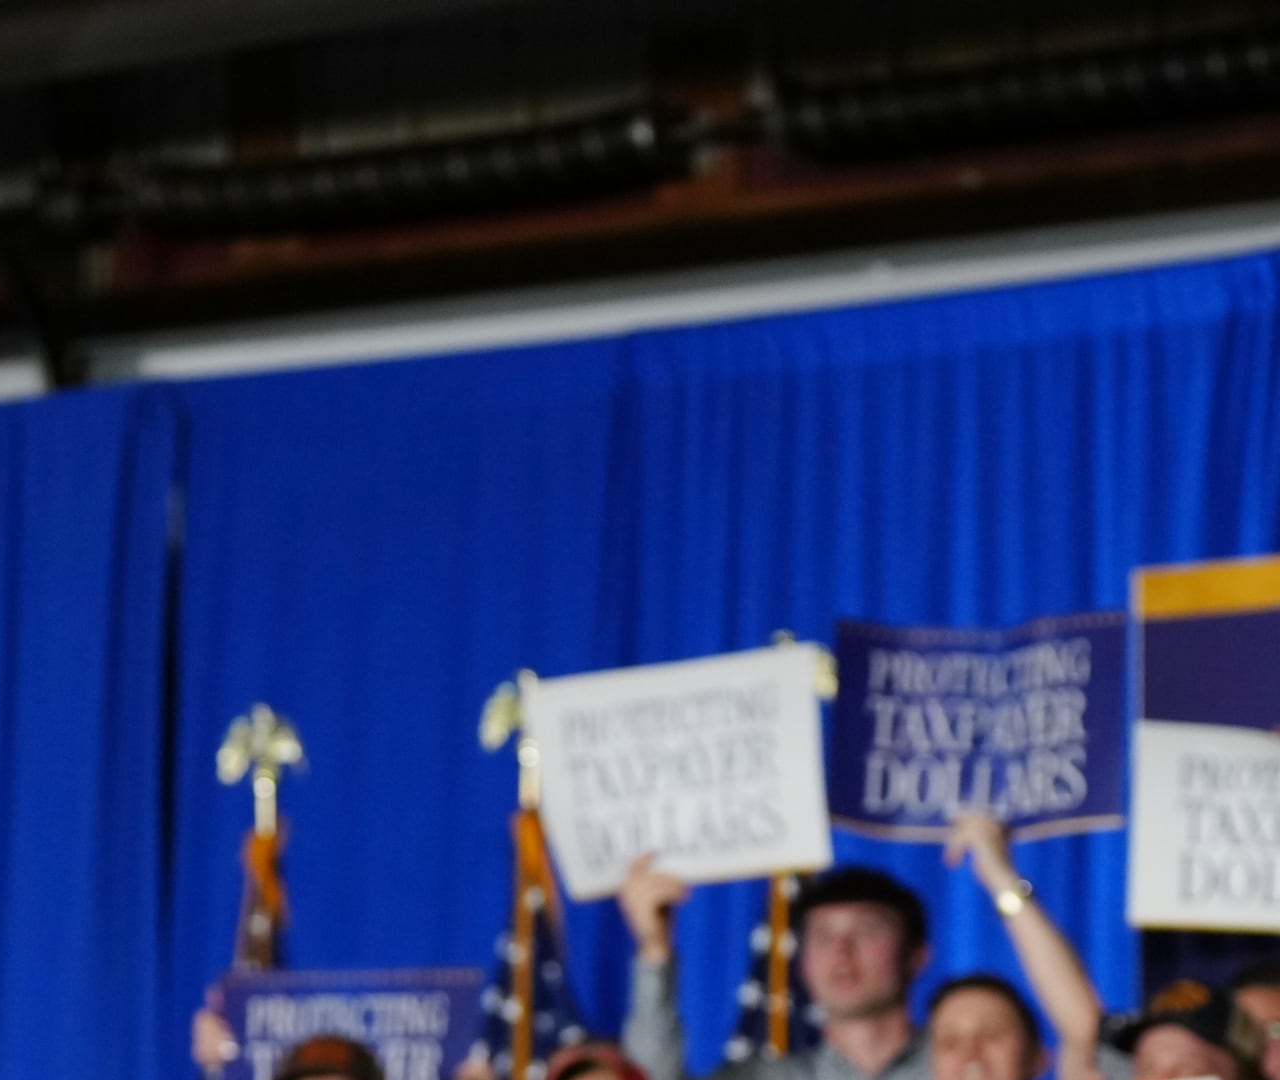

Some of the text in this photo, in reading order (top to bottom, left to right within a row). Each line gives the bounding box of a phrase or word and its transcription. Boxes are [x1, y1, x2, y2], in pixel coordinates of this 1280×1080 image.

[867, 638, 1092, 694] PROTECTING
[867, 691, 1088, 755] TAXPAYER
[864, 744, 1088, 817] DOLLARS
